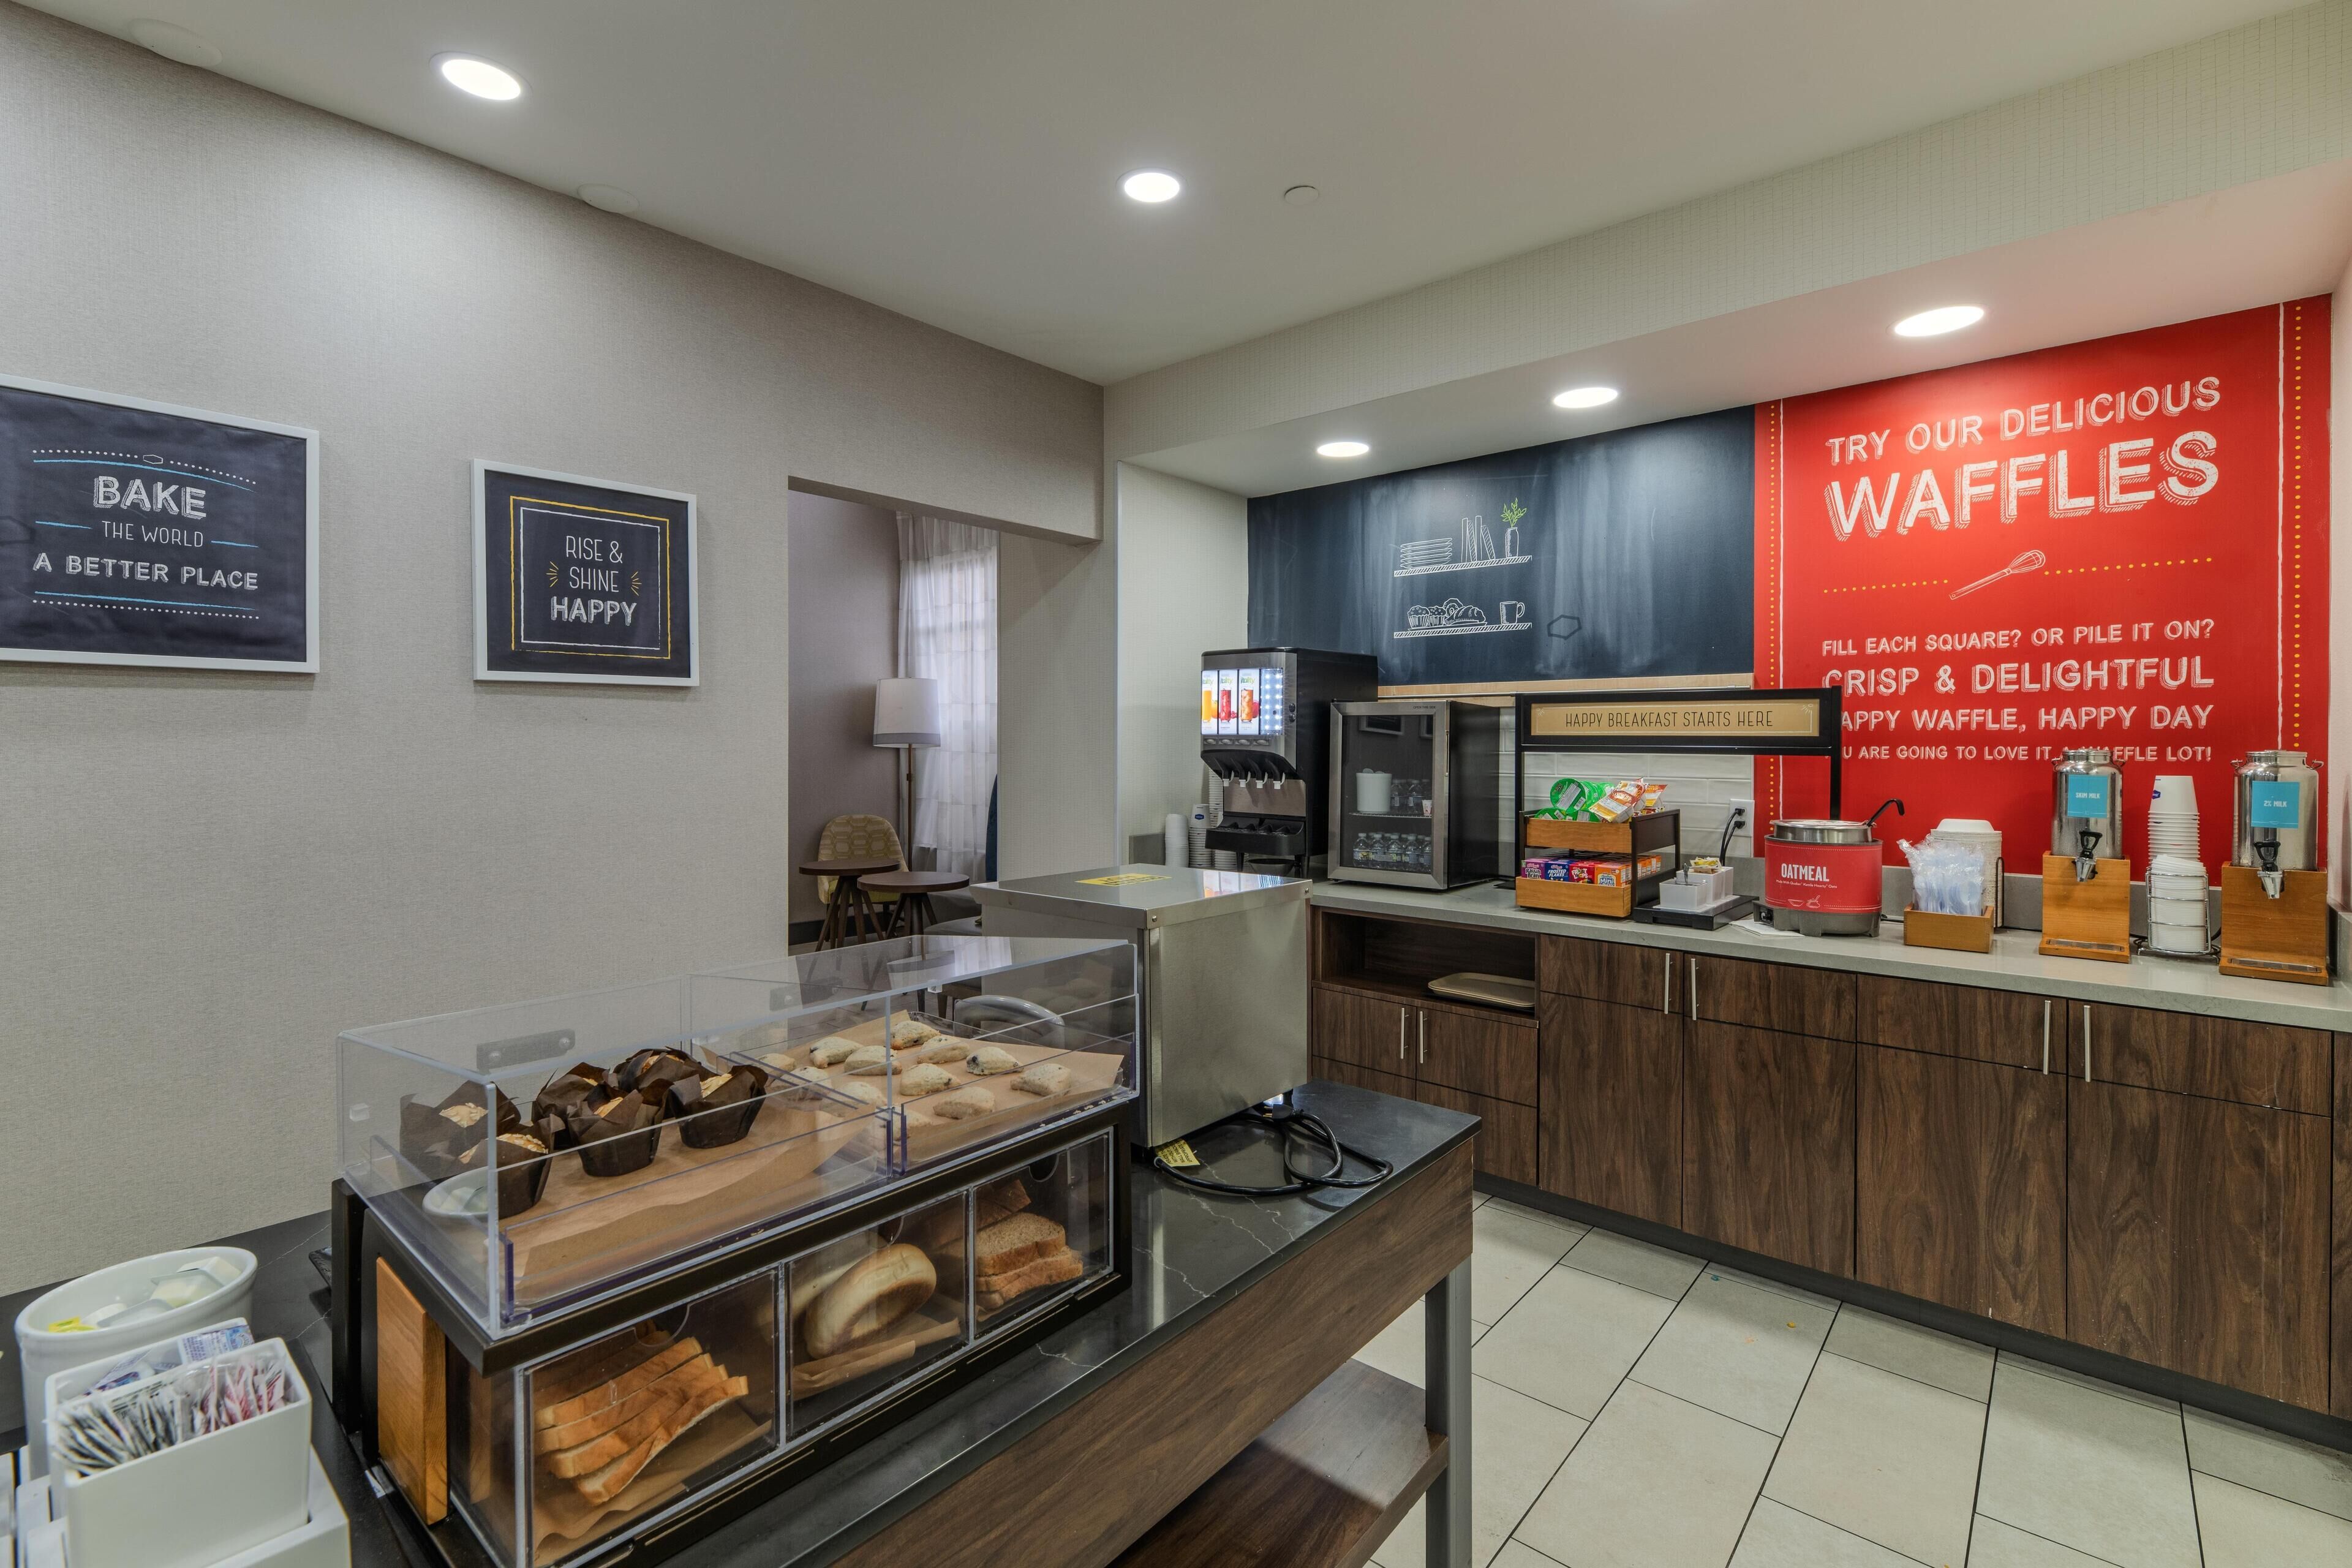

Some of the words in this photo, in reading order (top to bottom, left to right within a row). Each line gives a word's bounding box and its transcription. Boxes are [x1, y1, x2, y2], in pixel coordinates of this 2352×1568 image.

[1825, 429, 1890, 466] TRY
[1906, 415, 1984, 454] OUR
[2000, 377, 2220, 441] DELICIOUS
[93, 475, 206, 519] BAKE
[1824, 431, 2219, 542] WAFFLES
[102, 520, 134, 540] THE
[142, 525, 203, 547] WORLD
[566, 535, 603, 562] RISE
[609, 541, 623, 564] &
[32, 552, 52, 572] A
[66, 555, 168, 582] BETTER
[181, 566, 258, 590] PLACE
[569, 566, 619, 592] SHINE
[551, 596, 637, 626] HAPPY
[1822, 639, 1858, 657] FILL
[1866, 636, 1917, 655] EACH
[1925, 630, 2021, 651] SQUARE?
[2031, 627, 2064, 646] OR
[2073, 624, 2122, 644] PILE
[2132, 622, 2154, 641] IT
[2164, 619, 2215, 639] ON?
[1822, 667, 1919, 697] CRISP
[1935, 665, 1956, 694] &
[1972, 655, 2214, 693] DELIGHTFUL
[1566, 713, 1603, 728] HAPPY
[1608, 712, 1678, 728] BREAKFAST
[1683, 711, 1731, 727] STARTS
[1738, 710, 1773, 726] HERE
[1841, 710, 1901, 731] APPY
[1911, 707, 2026, 733] WAFFLE,
[2038, 706, 2137, 730] HAPPY
[2150, 705, 2214, 729] DAY
[1858, 745, 1890, 760] ARE
[1896, 745, 1948, 760] GOING
[1955, 745, 1977, 760] TO
[1984, 745, 2028, 760] LOVE
[2036, 745, 2052, 760] IT
[2078, 745, 2158, 761] FFLE
[2166, 745, 2211, 761] LOT!
[1781, 863, 1830, 882] OATMEAL
